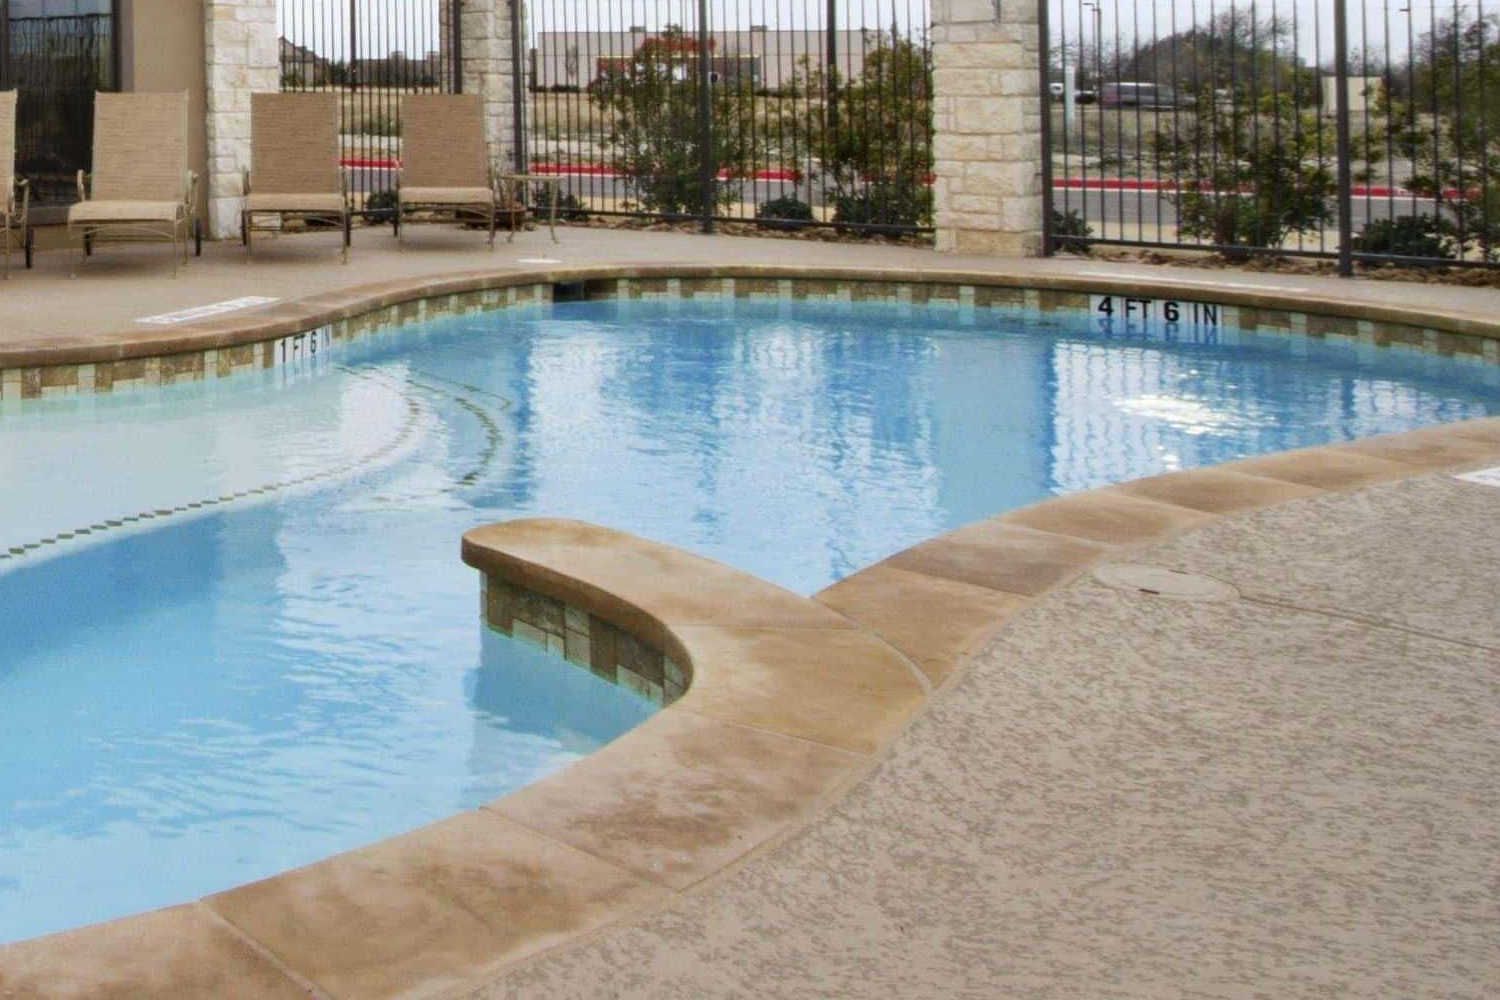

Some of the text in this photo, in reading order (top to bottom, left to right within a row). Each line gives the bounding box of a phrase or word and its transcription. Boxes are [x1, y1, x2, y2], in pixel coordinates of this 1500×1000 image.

[1098, 296, 1217, 325] 4 FT 6 IN
[281, 339, 286, 362] 1
[293, 334, 305, 357] FT
[310, 331, 317, 353] 6
